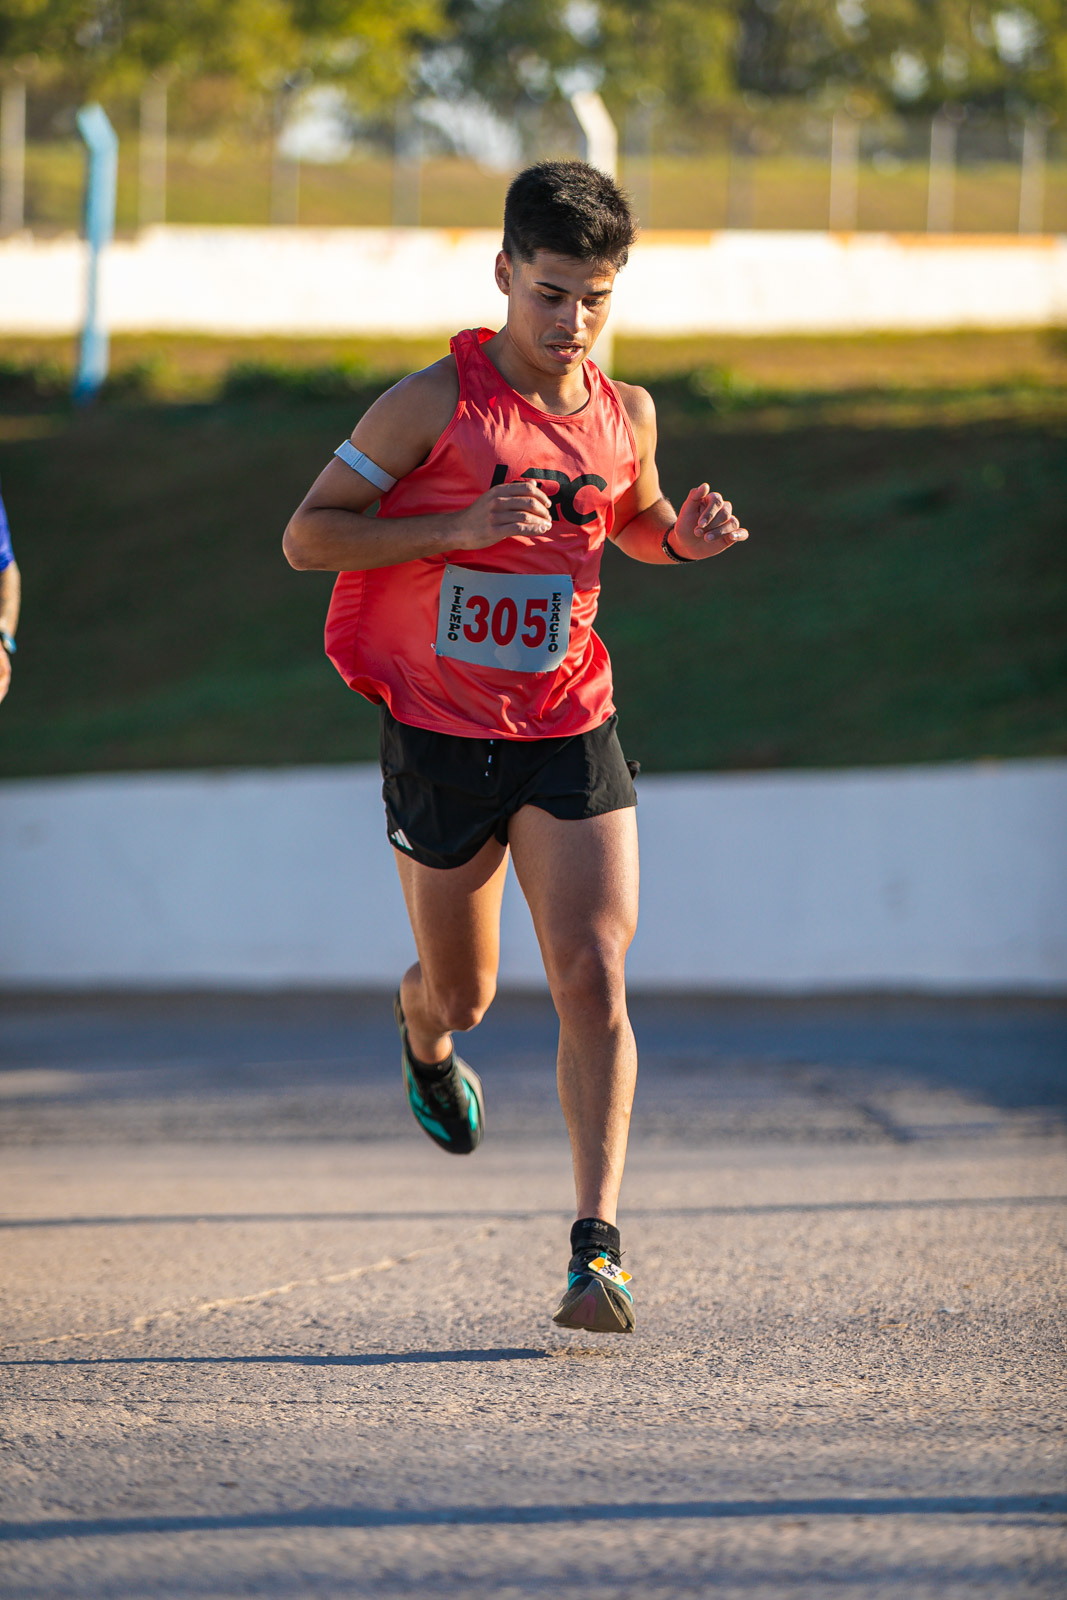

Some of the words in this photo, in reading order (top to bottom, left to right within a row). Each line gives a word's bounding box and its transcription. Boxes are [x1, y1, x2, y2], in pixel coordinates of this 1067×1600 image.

[447, 585, 464, 641] TIEMPO
[463, 595, 548, 648] 305
[548, 592, 561, 653] EXACTO
